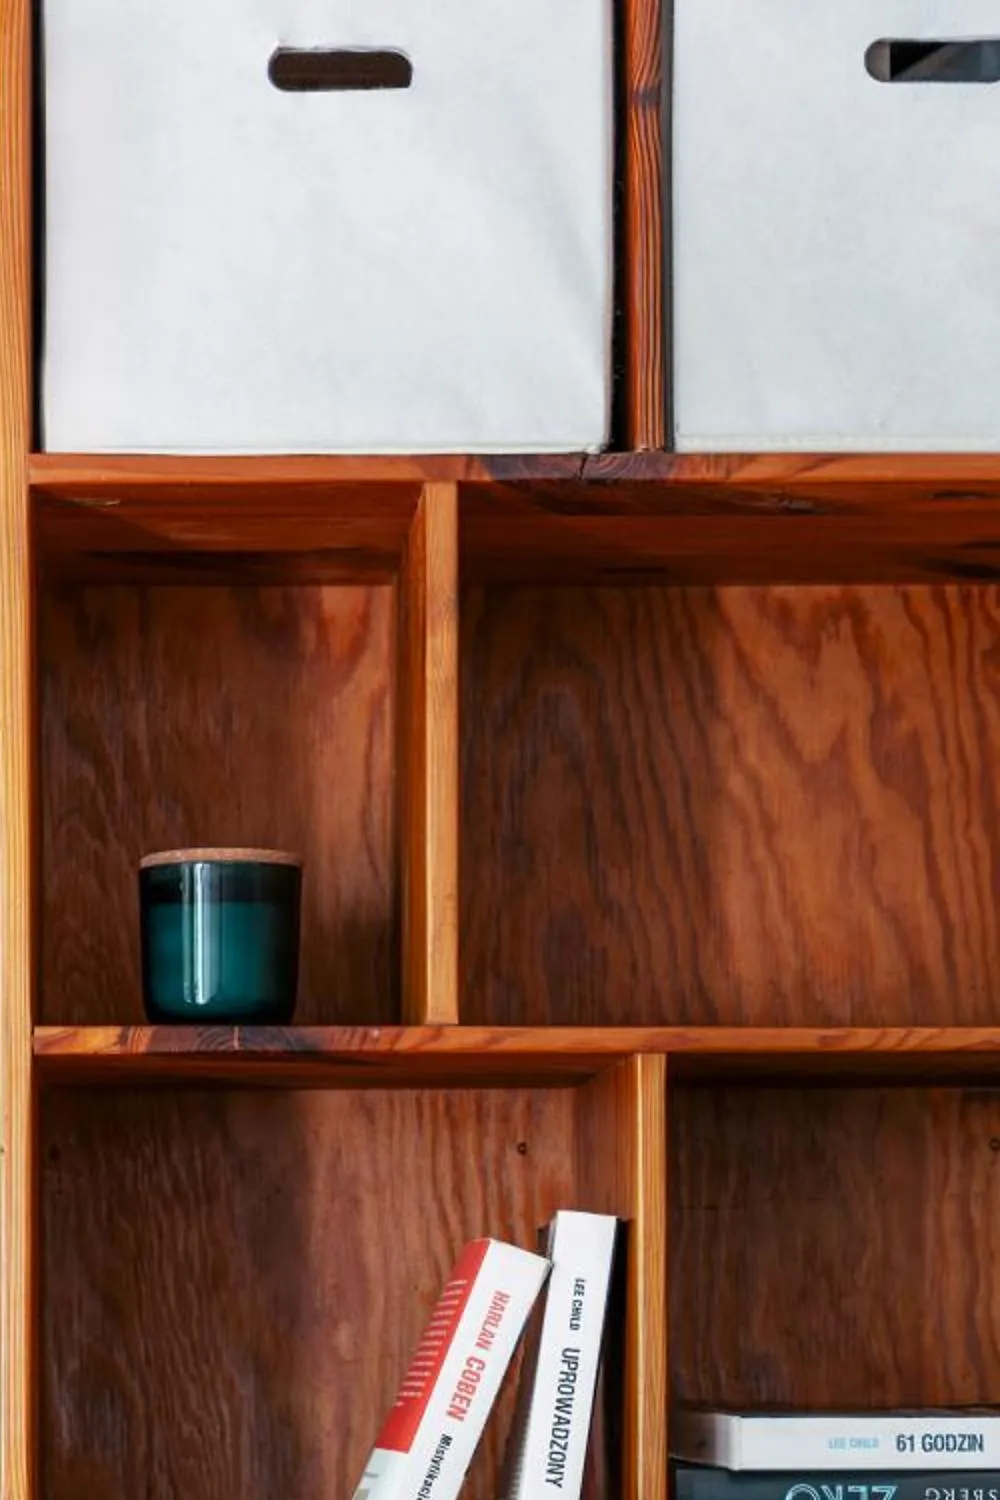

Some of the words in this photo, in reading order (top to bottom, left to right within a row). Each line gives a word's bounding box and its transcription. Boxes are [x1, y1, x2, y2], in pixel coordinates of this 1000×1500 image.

[573, 1278, 587, 1298] LEE
[474, 1290, 511, 1352] HARLAN
[568, 1299, 583, 1331] CHILD
[445, 1356, 487, 1423] COBEN
[545, 1348, 582, 1489] UPROWADZONY
[896, 1433, 916, 1453] 61
[921, 1432, 985, 1454] GODZIN
